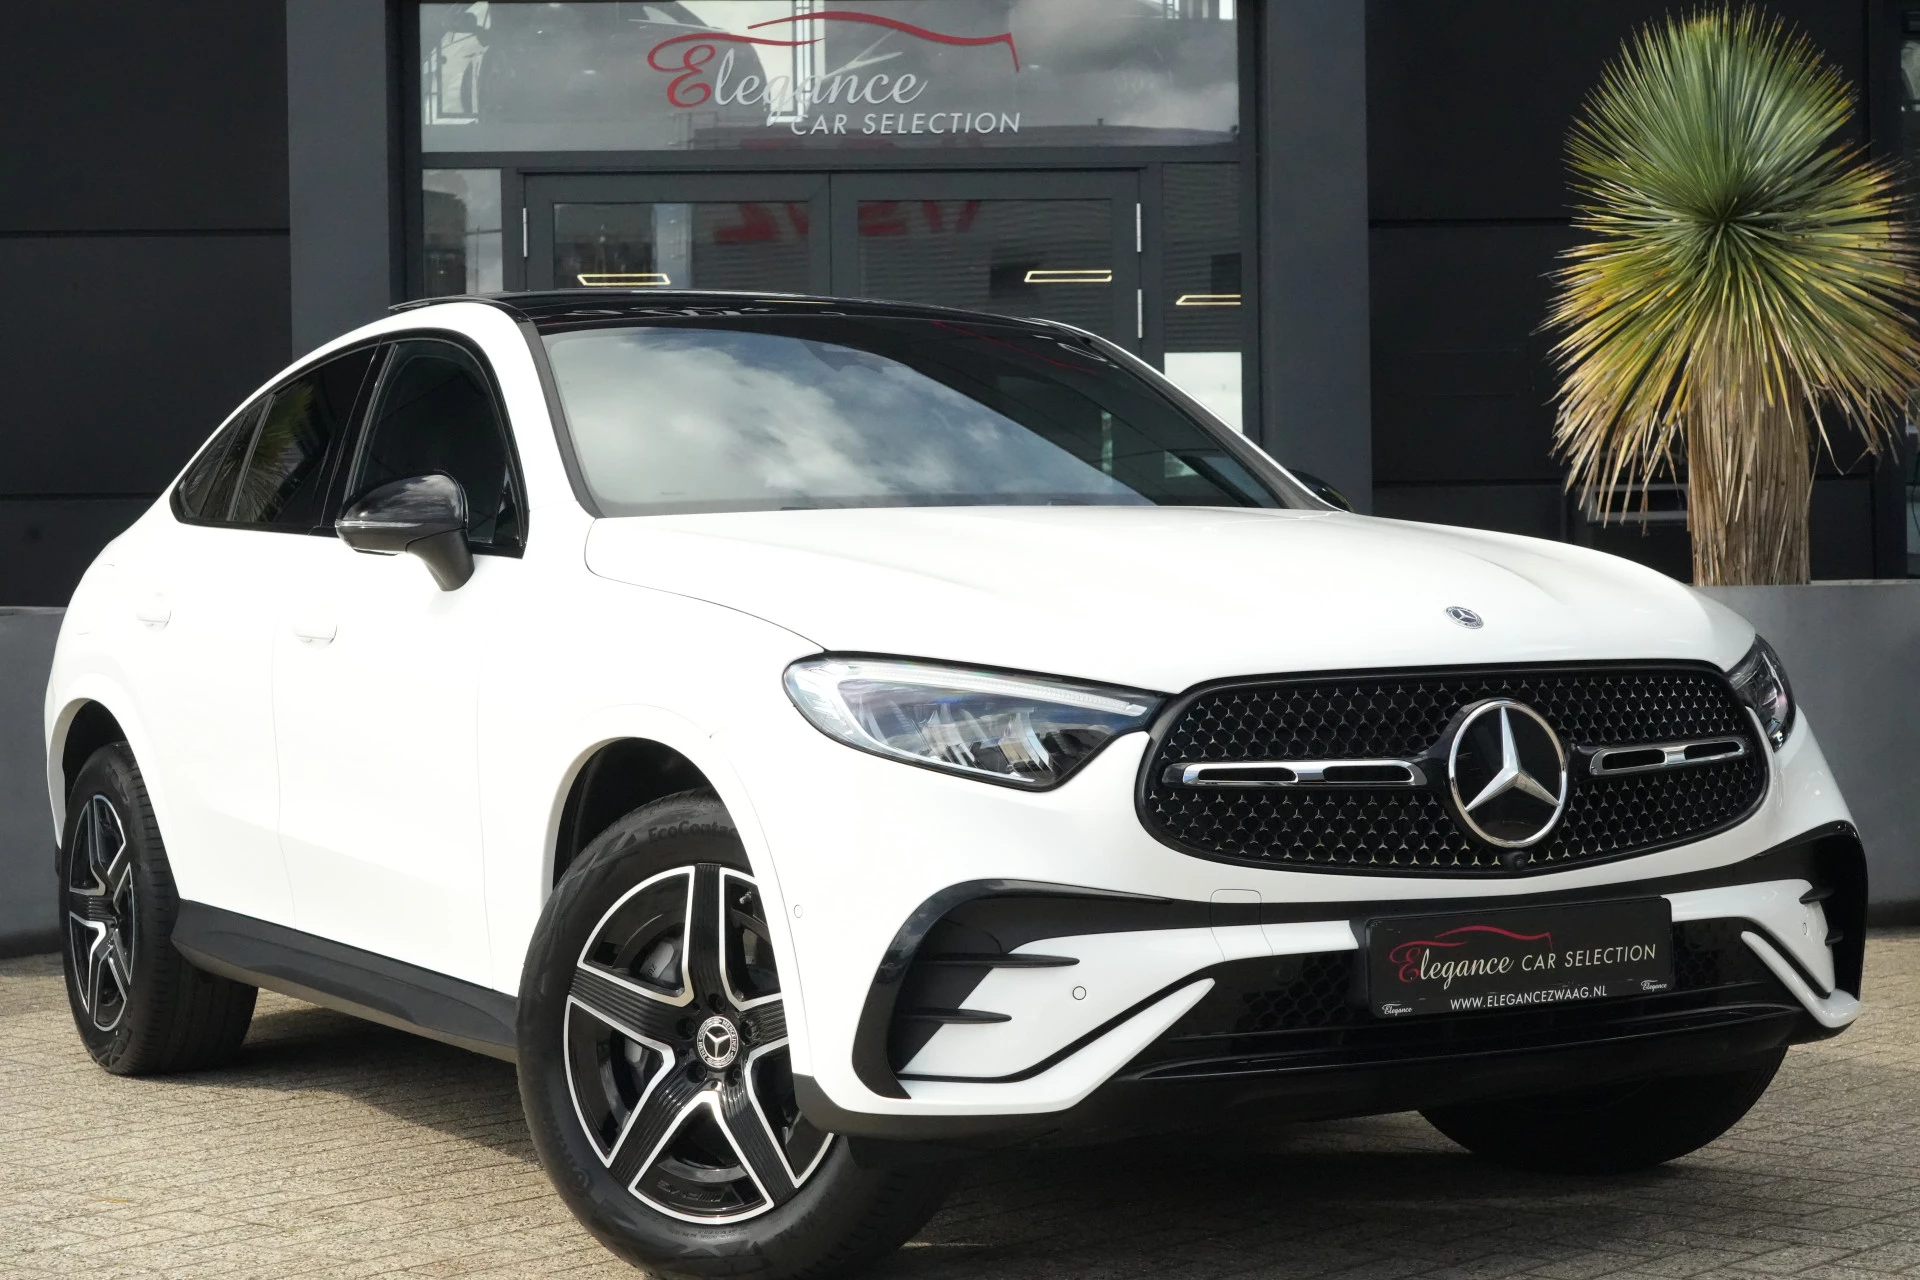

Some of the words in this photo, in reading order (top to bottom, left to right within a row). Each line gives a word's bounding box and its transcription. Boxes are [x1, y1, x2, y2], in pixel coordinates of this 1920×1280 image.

[647, 33, 928, 127] Elegance
[790, 113, 847, 136] CAR
[862, 112, 1021, 135] SELECTION
[1390, 941, 1514, 990] Elegance
[1521, 952, 1557, 972] CAR
[1564, 944, 1657, 968] SELECTION
[1381, 1003, 1413, 1016] Elegance
[1450, 985, 1608, 1010] WWW.ELEGANCEZWAAG.NL
